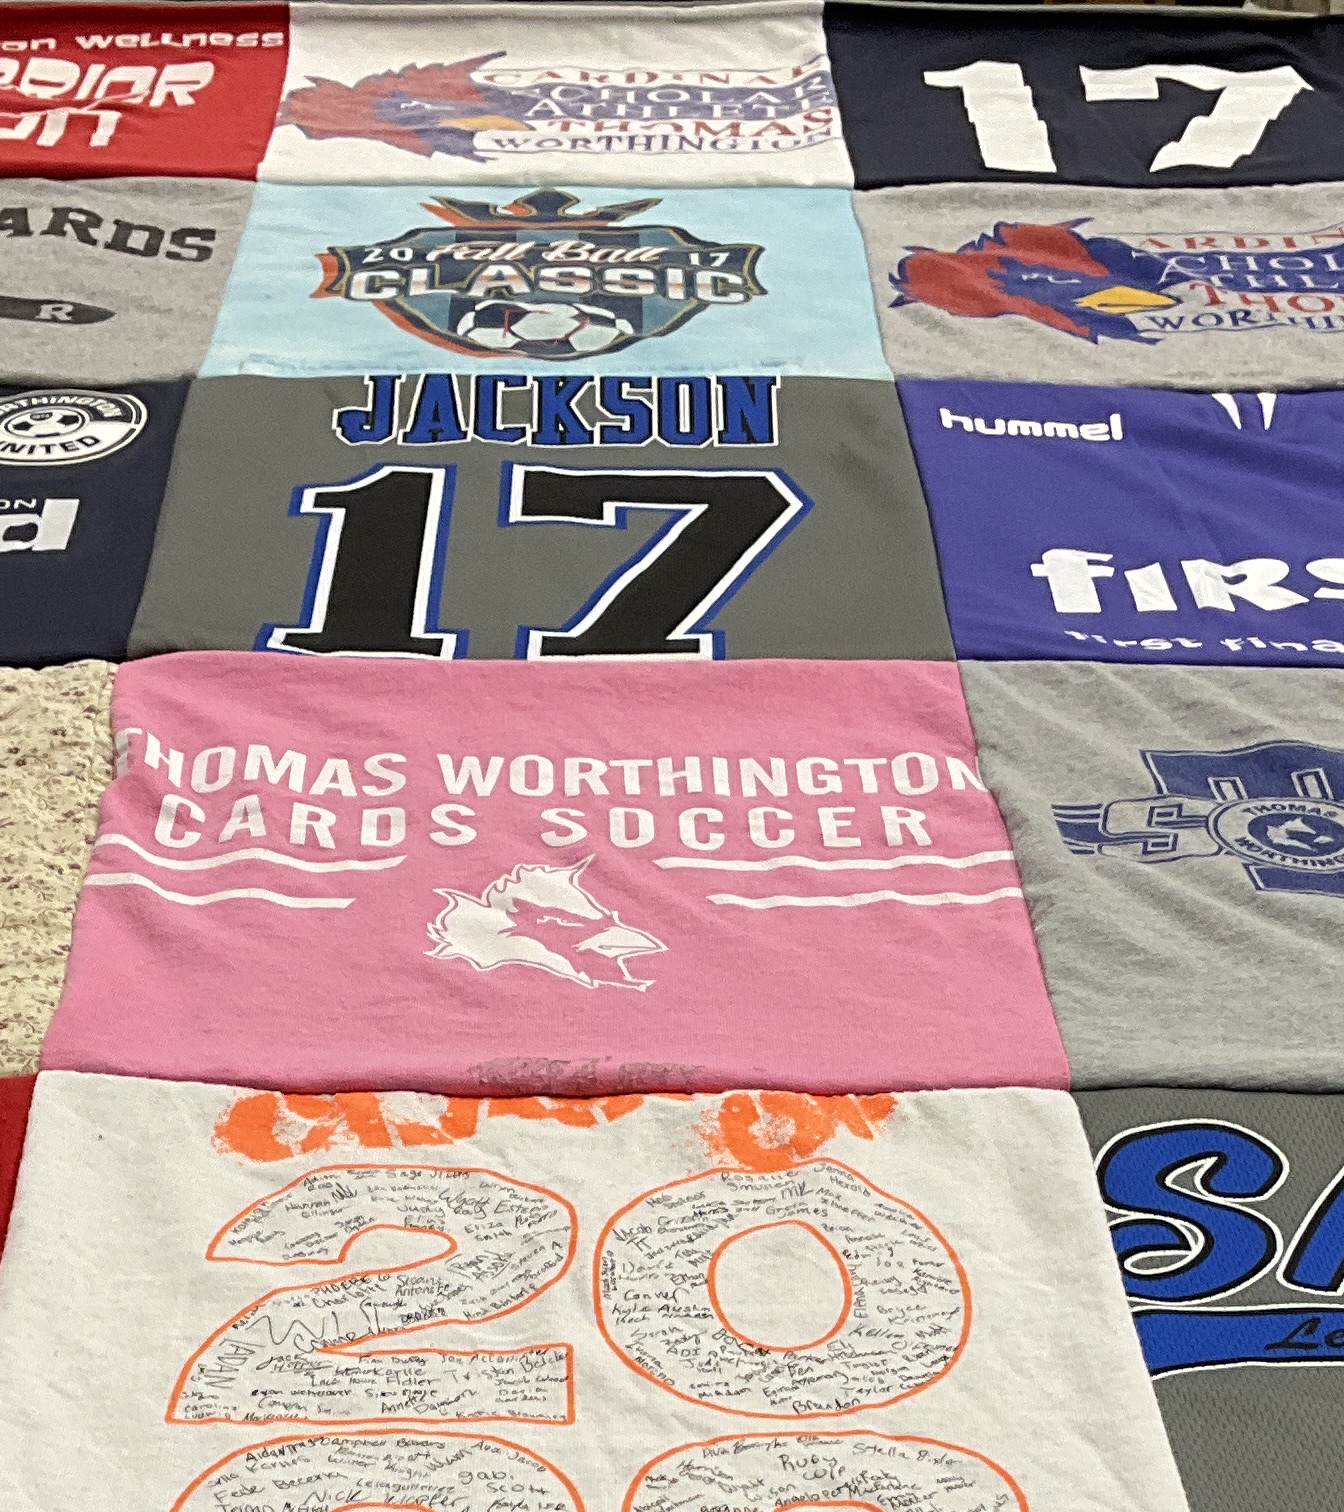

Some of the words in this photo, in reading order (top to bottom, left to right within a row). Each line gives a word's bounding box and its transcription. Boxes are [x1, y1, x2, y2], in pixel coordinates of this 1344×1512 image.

[924, 60, 1314, 173] 17
[541, 240, 662, 263] Ball
[349, 263, 749, 302] CLASSIC
[333, 374, 781, 446] JACKSON
[939, 406, 1124, 442] hummel
[256, 461, 814, 661] 17
[439, 751, 990, 797] WORTHINGTON
[154, 793, 478, 849] CARDS
[540, 805, 933, 848] SOCCER
